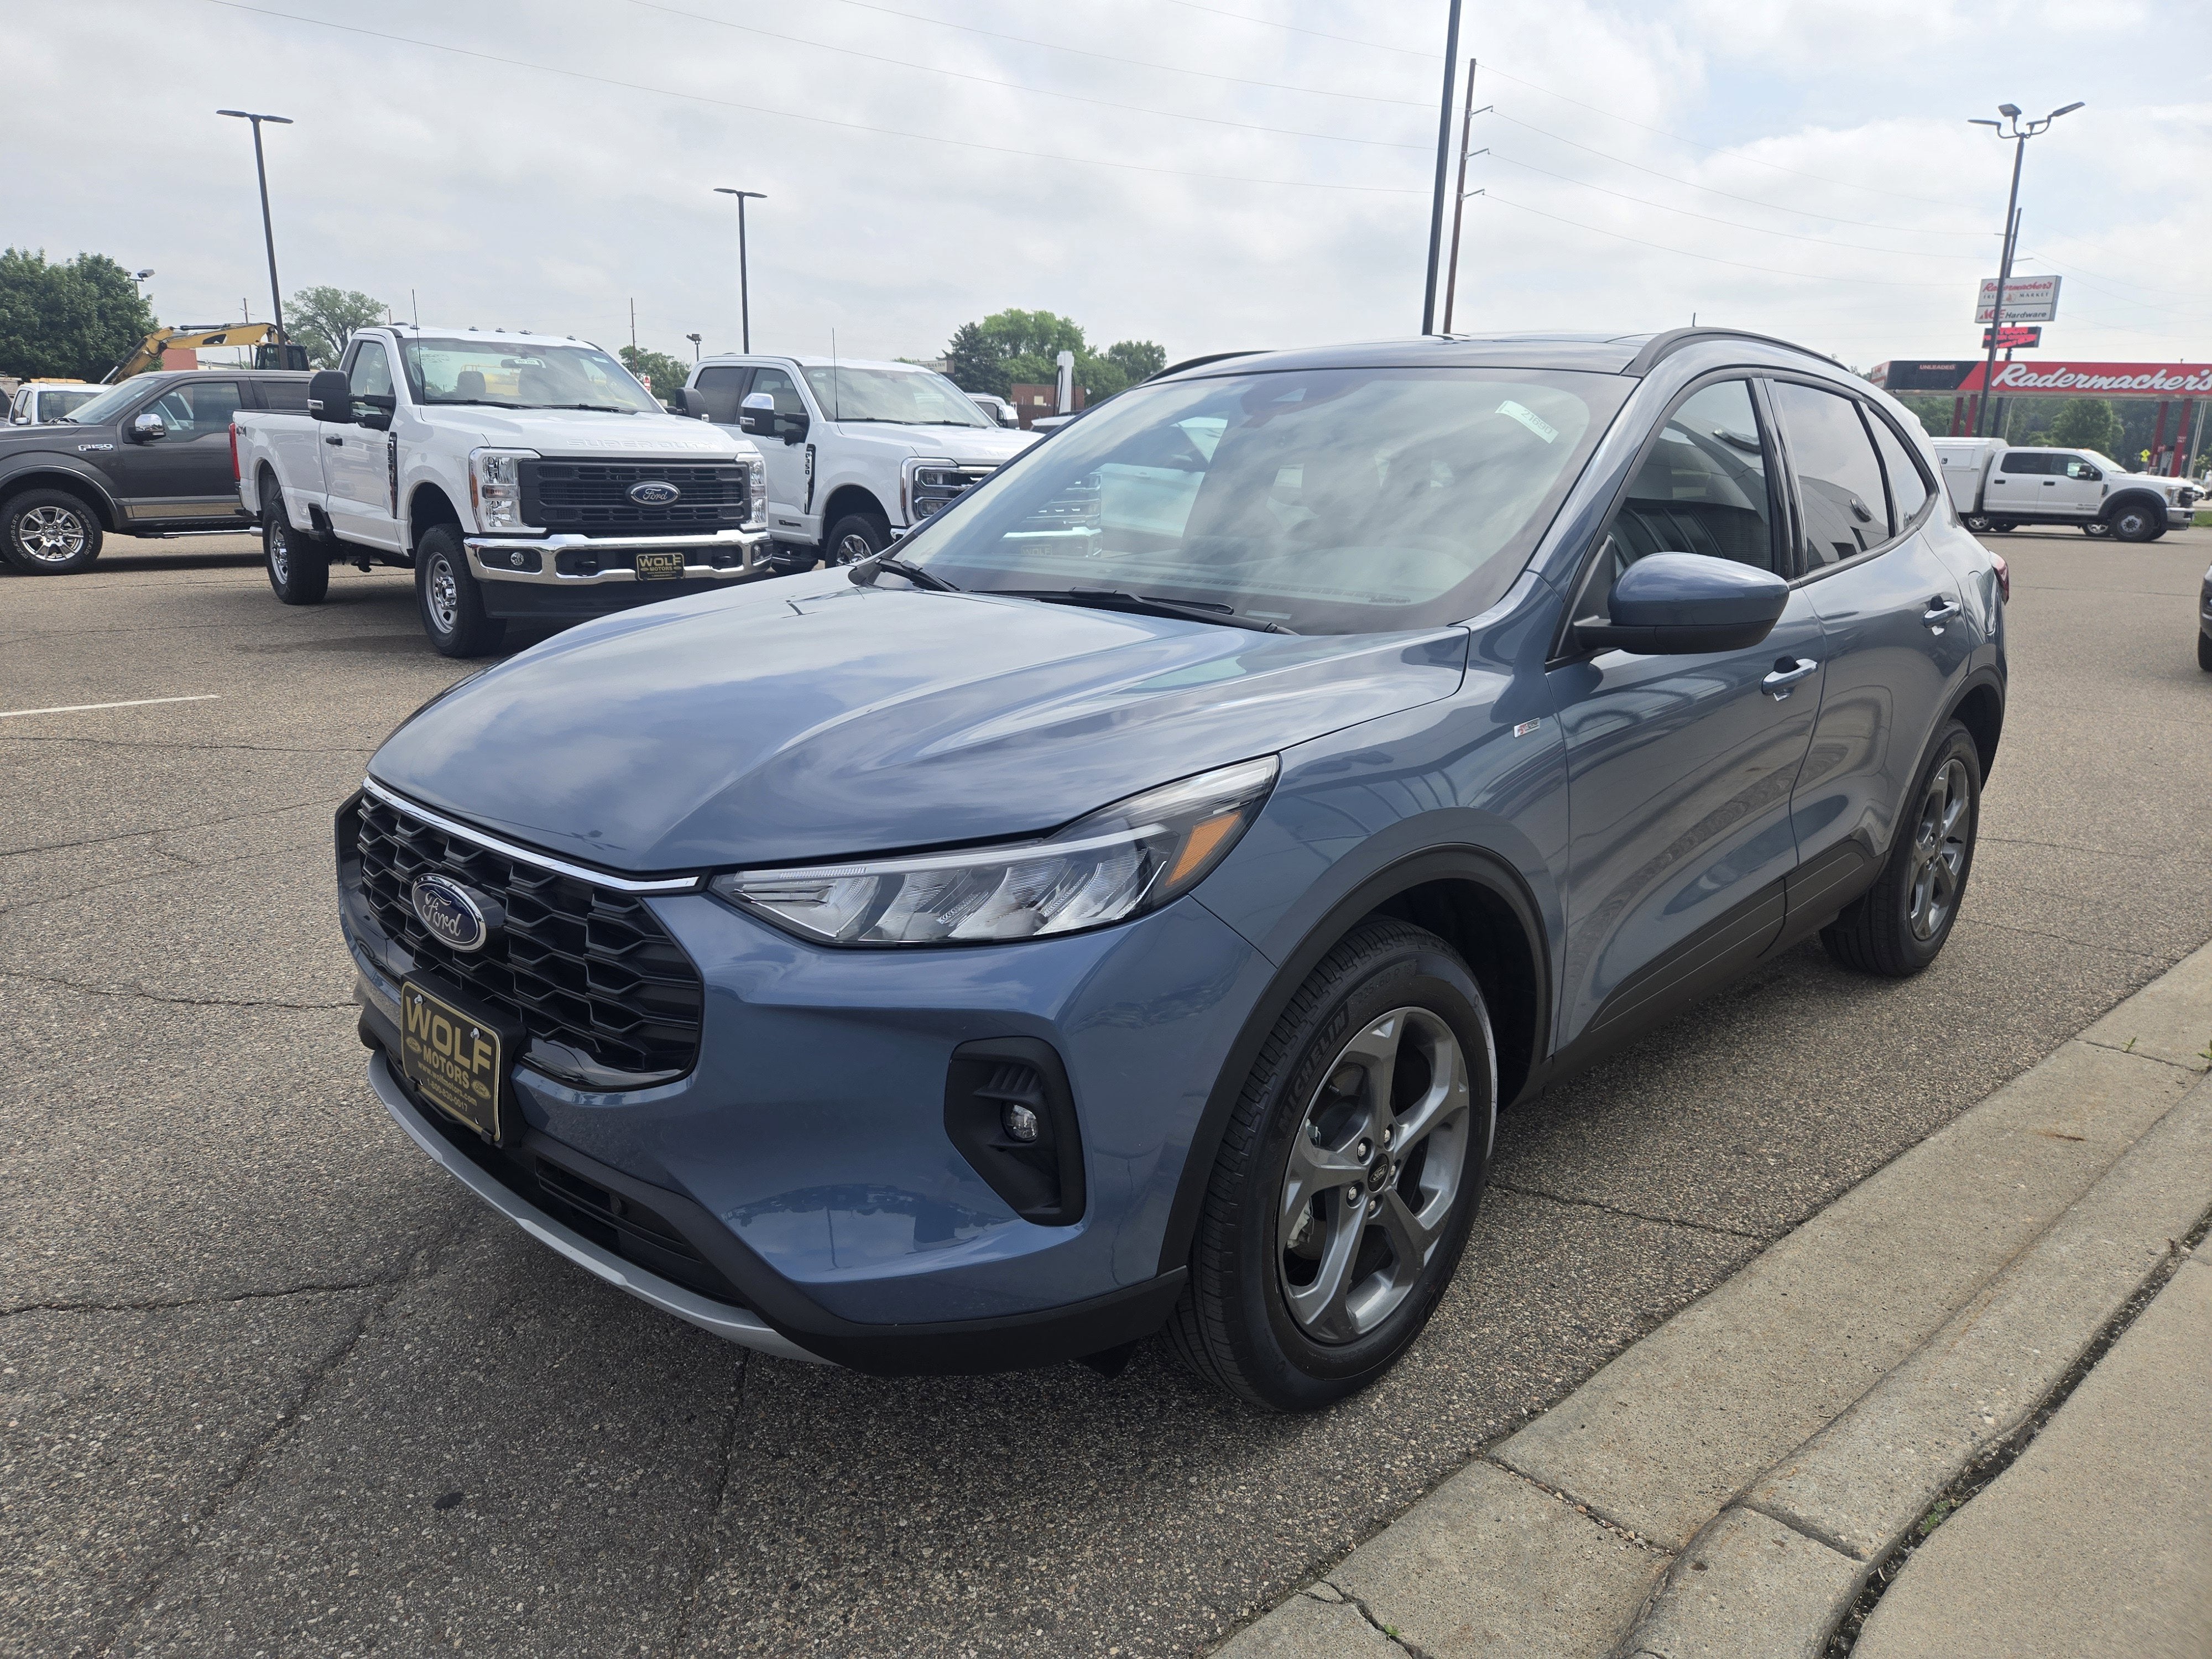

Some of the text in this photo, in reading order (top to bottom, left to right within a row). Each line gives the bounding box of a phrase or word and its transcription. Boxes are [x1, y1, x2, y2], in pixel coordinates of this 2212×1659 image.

[1983, 281, 2053, 292] Raermacher's
[1992, 363, 2212, 391] Radermacher's
[643, 488, 668, 500] Ford
[639, 556, 681, 567] WOLF
[422, 889, 462, 937] Ford
[405, 995, 492, 1074] WOLF
[418, 1060, 477, 1107] www.wolfmotors.com
[422, 1044, 470, 1089] MOTORS
[1277, 1010, 1347, 1133] MICHELIN
[1373, 1167, 1385, 1181] Ford
